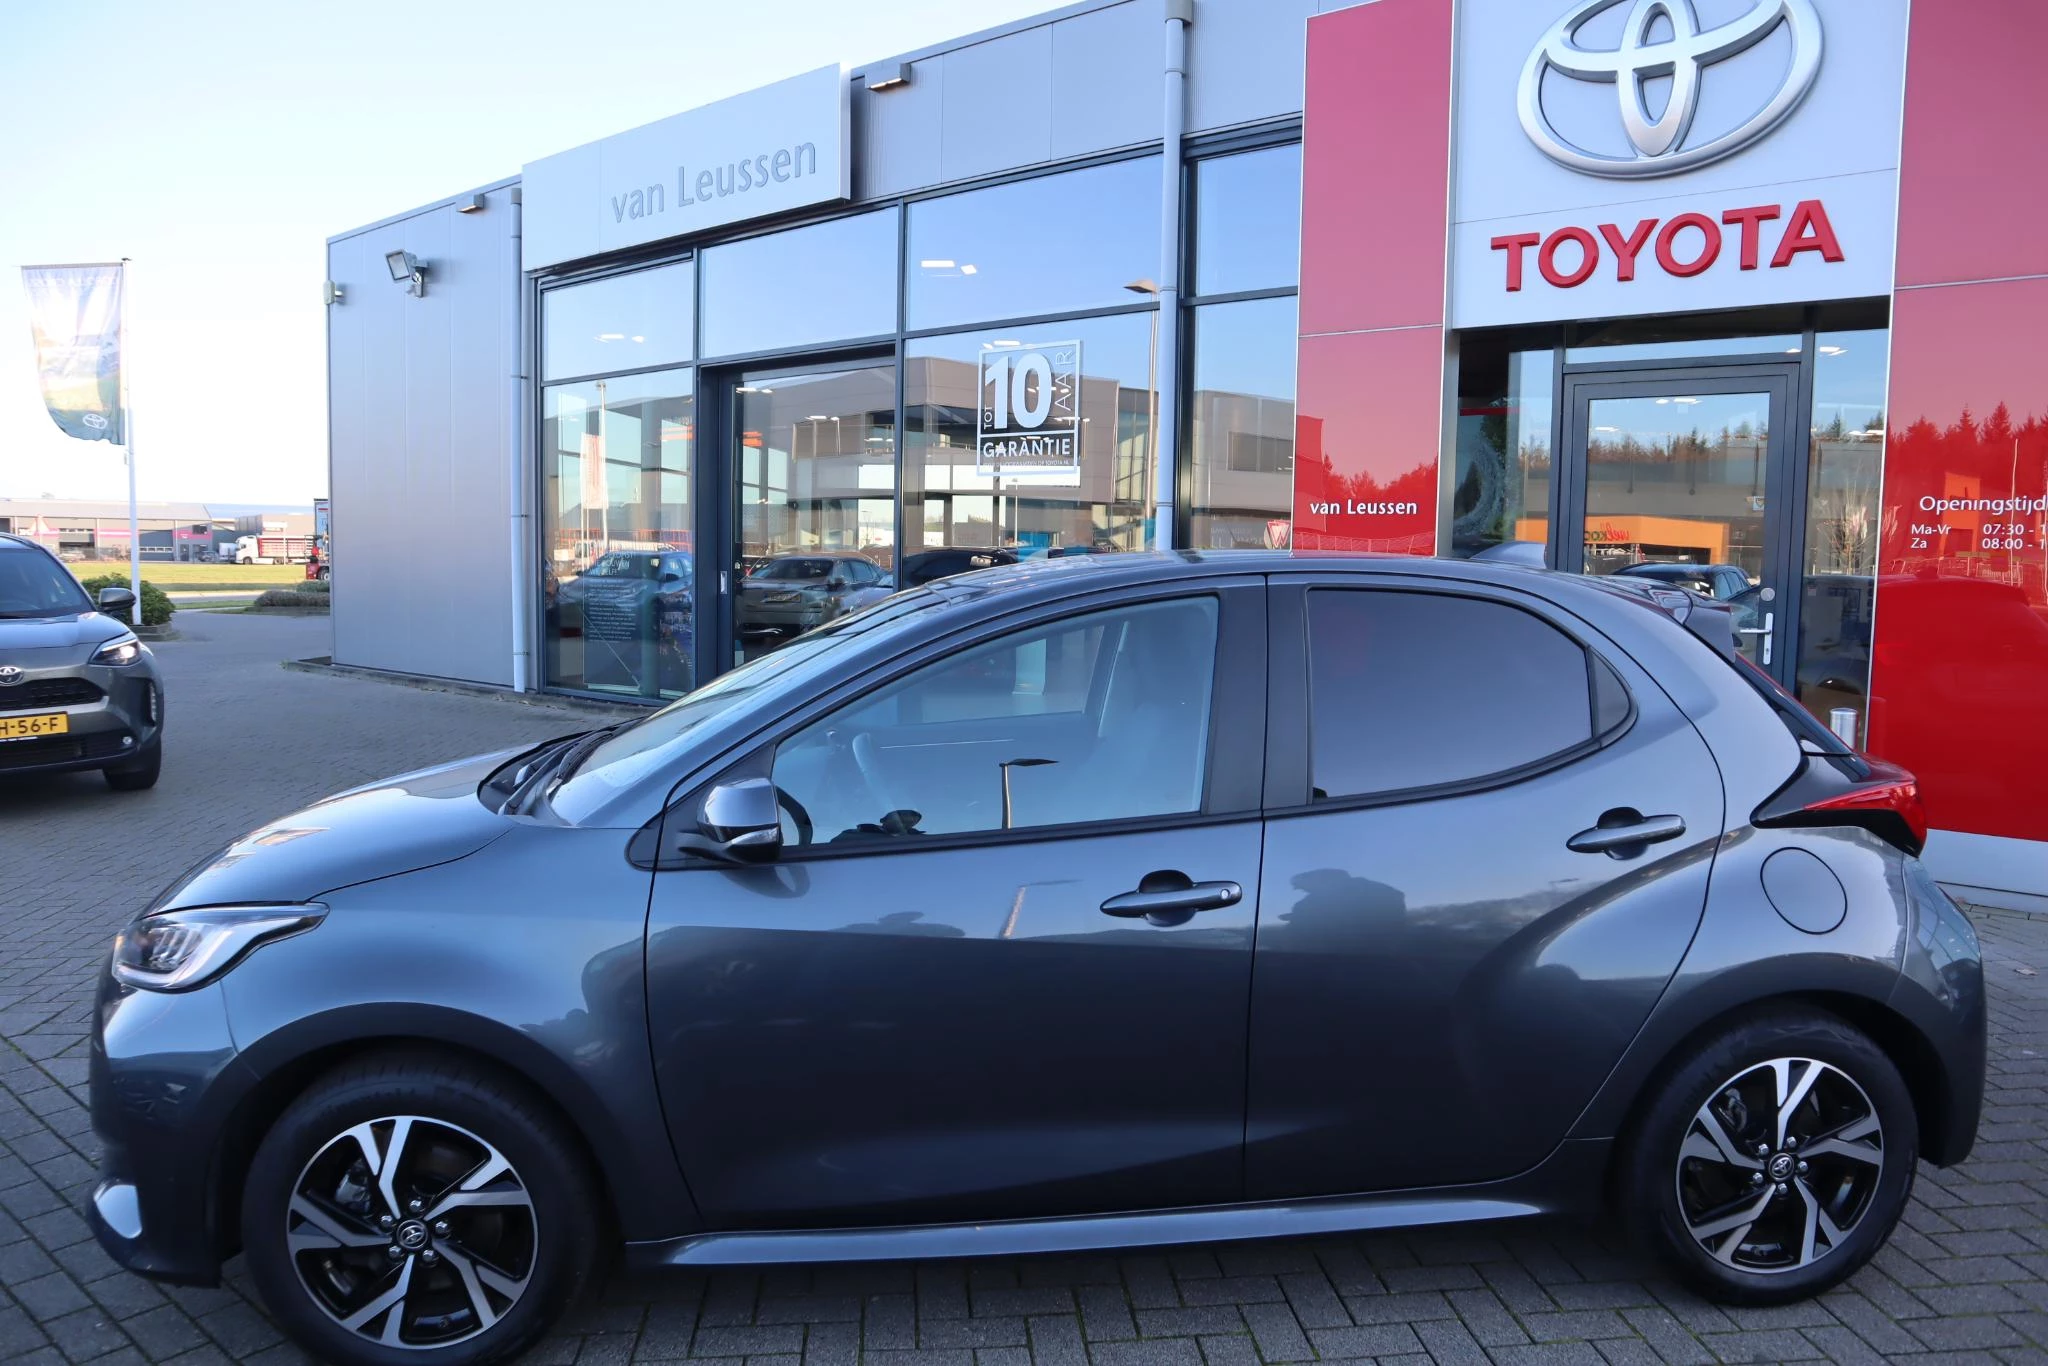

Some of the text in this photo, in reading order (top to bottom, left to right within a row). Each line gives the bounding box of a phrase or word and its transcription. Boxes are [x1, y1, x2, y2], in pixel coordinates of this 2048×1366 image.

[610, 141, 816, 223] van Leussen
[1491, 199, 1846, 292] TOYOTA
[985, 352, 1052, 430] 10
[983, 404, 993, 430] TOT
[983, 438, 1070, 457] GARANTIE
[1309, 499, 1418, 515] van Leussen
[1919, 494, 2047, 516] Openingstijd
[1911, 524, 1951, 535] Ma-Vr
[1983, 524, 2024, 535] 07:30
[1911, 538, 1927, 549] Za
[1982, 538, 2023, 549] 08:00
